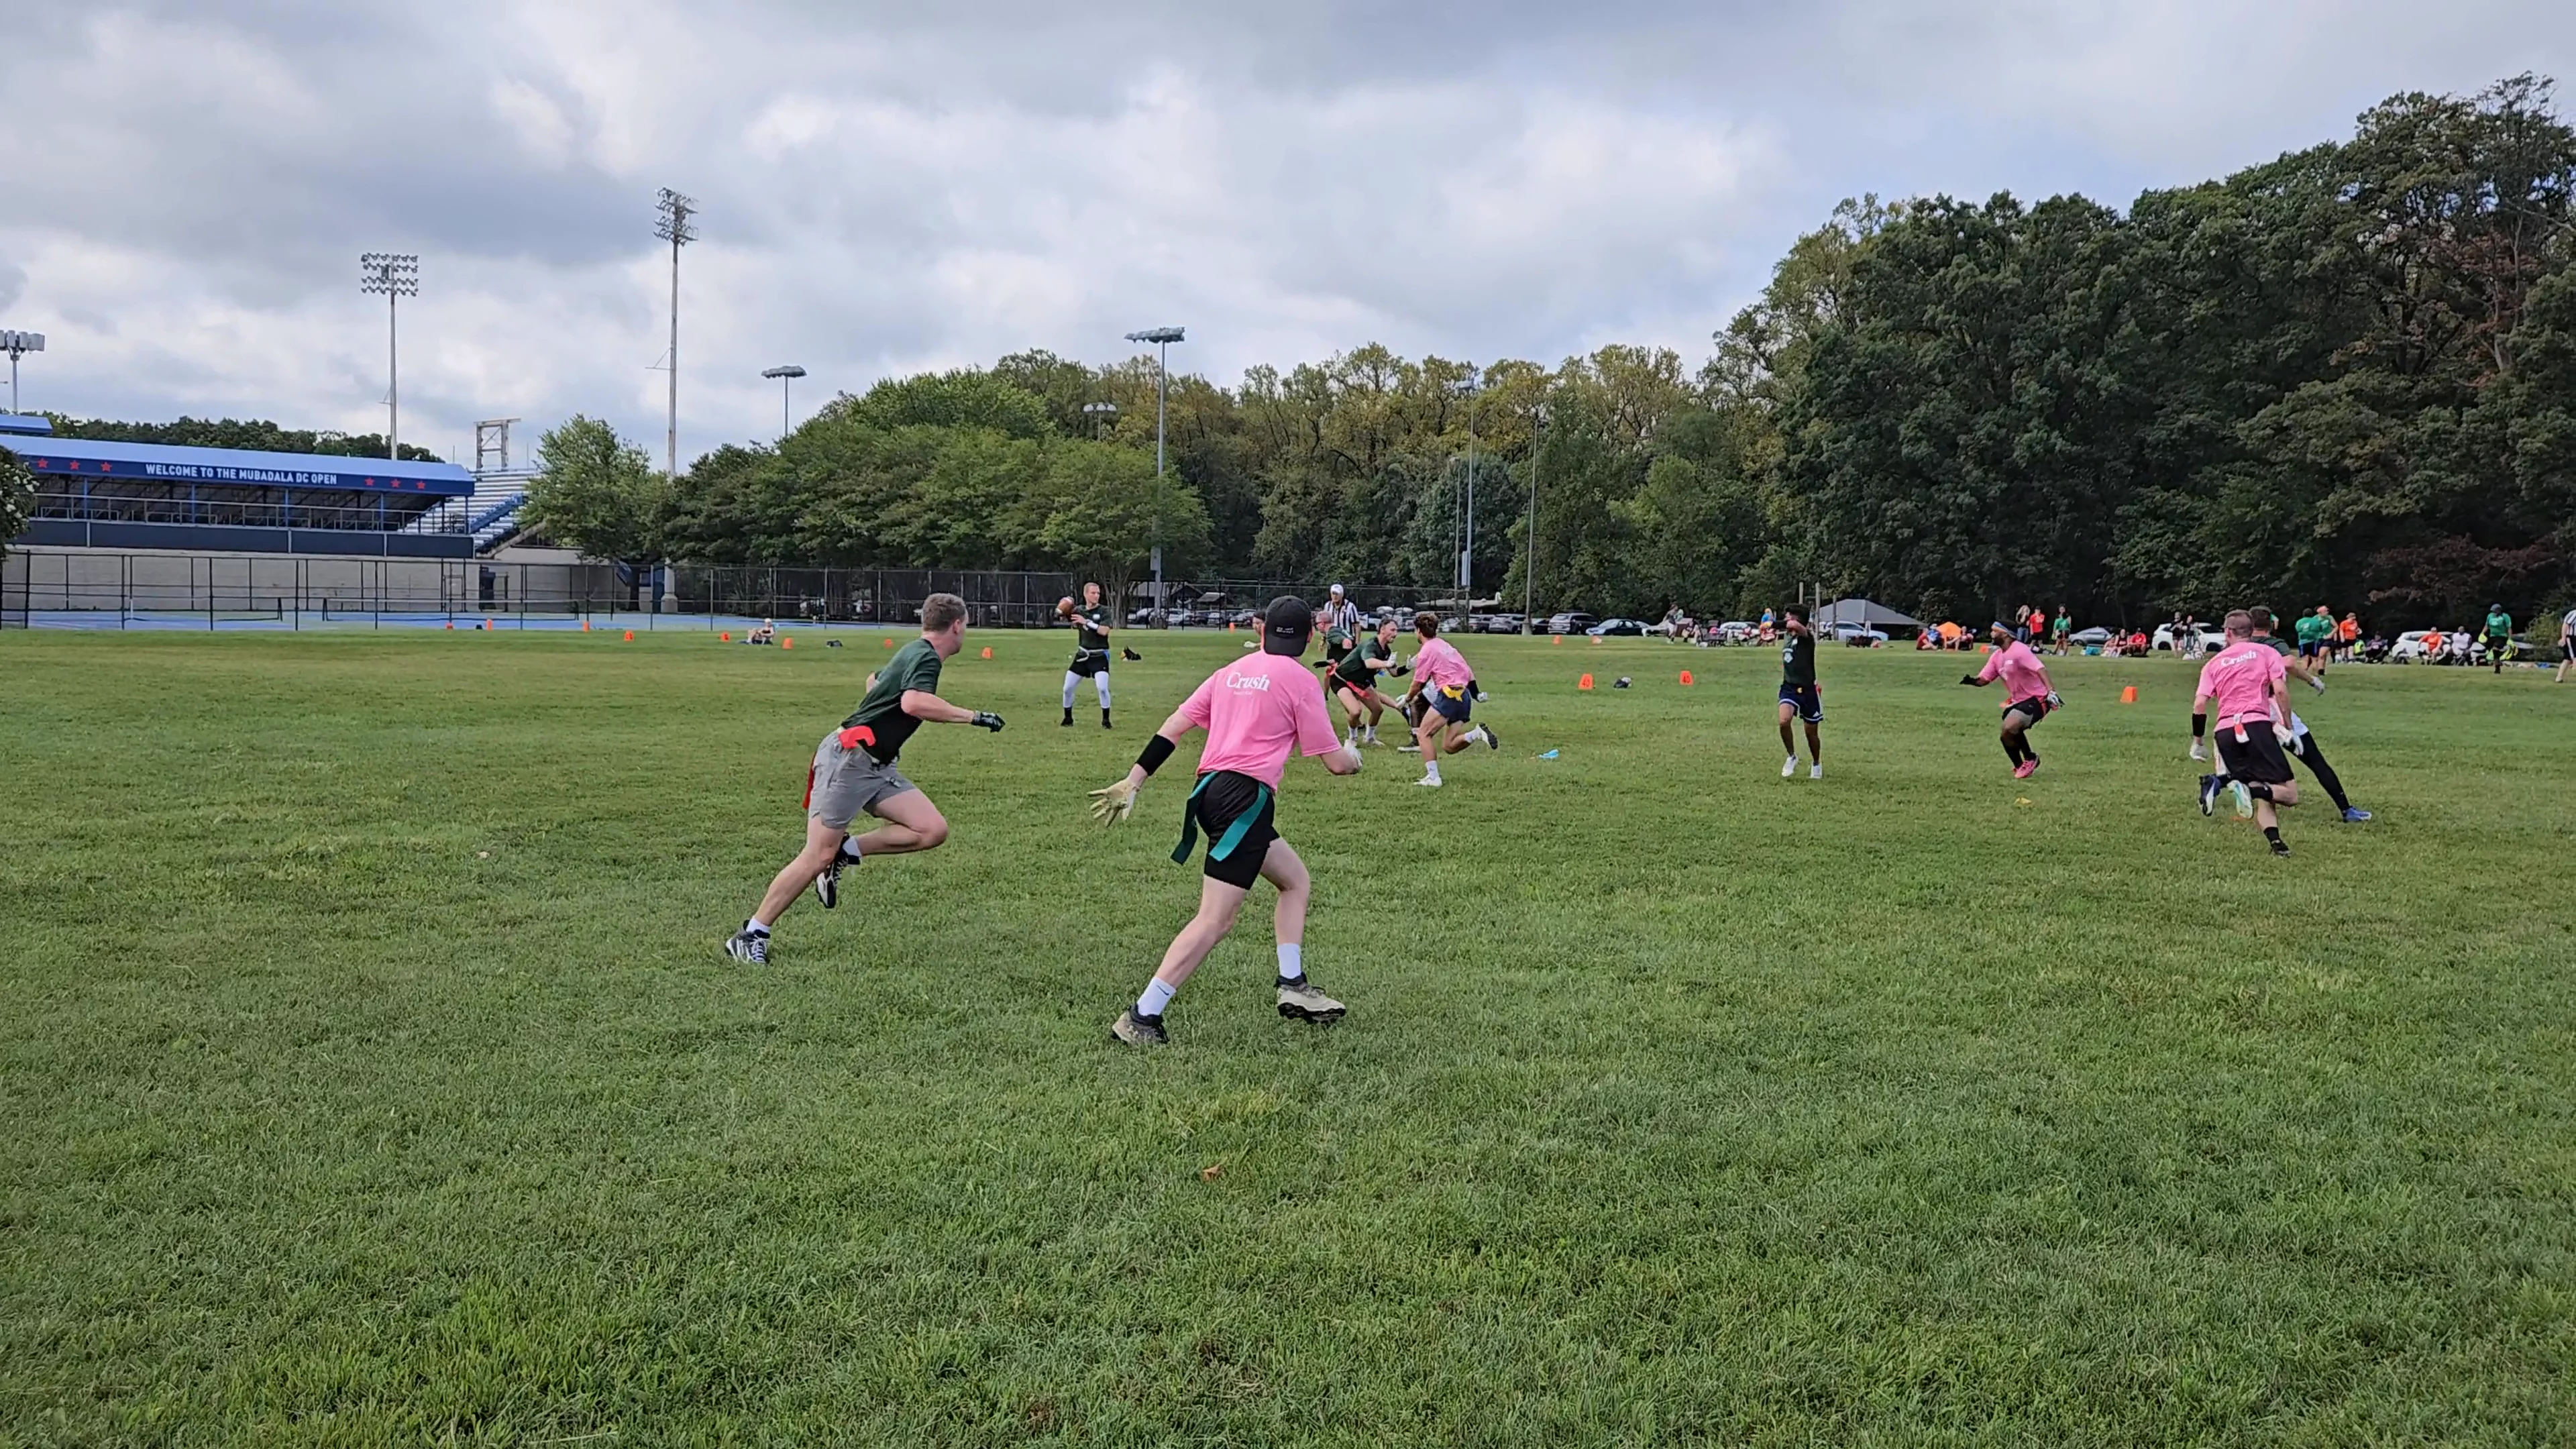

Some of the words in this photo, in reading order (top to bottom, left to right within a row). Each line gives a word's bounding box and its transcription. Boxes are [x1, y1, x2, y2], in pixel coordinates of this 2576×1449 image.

[146, 464, 198, 477] WELCOME
[200, 467, 214, 478] TO
[216, 468, 237, 479] THE
[239, 469, 294, 482] MUBADALA
[296, 472, 309, 483] DC
[311, 474, 337, 484] OPEN
[2221, 650, 2257, 665] Crush
[1226, 672, 1270, 692] Crush
